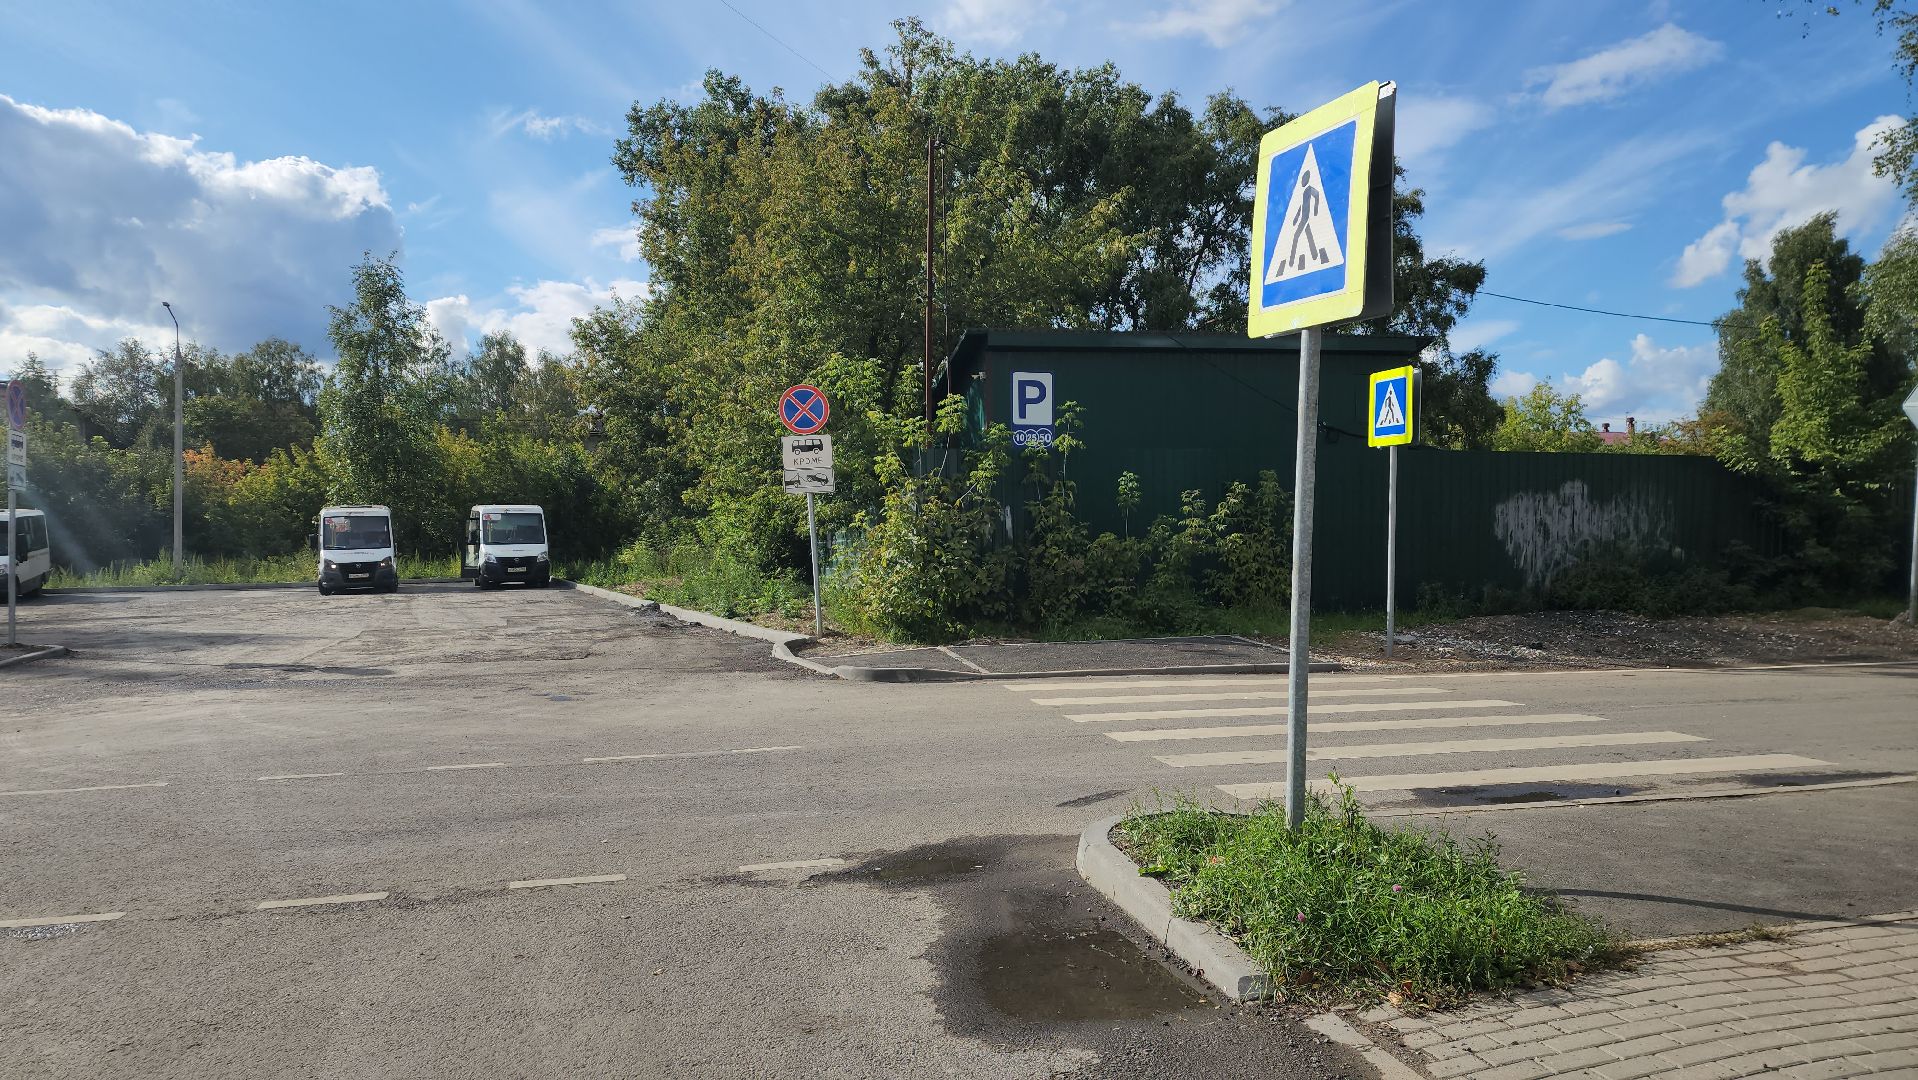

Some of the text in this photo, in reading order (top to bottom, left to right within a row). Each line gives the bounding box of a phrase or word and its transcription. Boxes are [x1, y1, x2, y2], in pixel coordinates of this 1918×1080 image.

[1018, 380, 1047, 419] P
[1015, 433, 1025, 441] 10
[1040, 433, 1051, 443] 50
